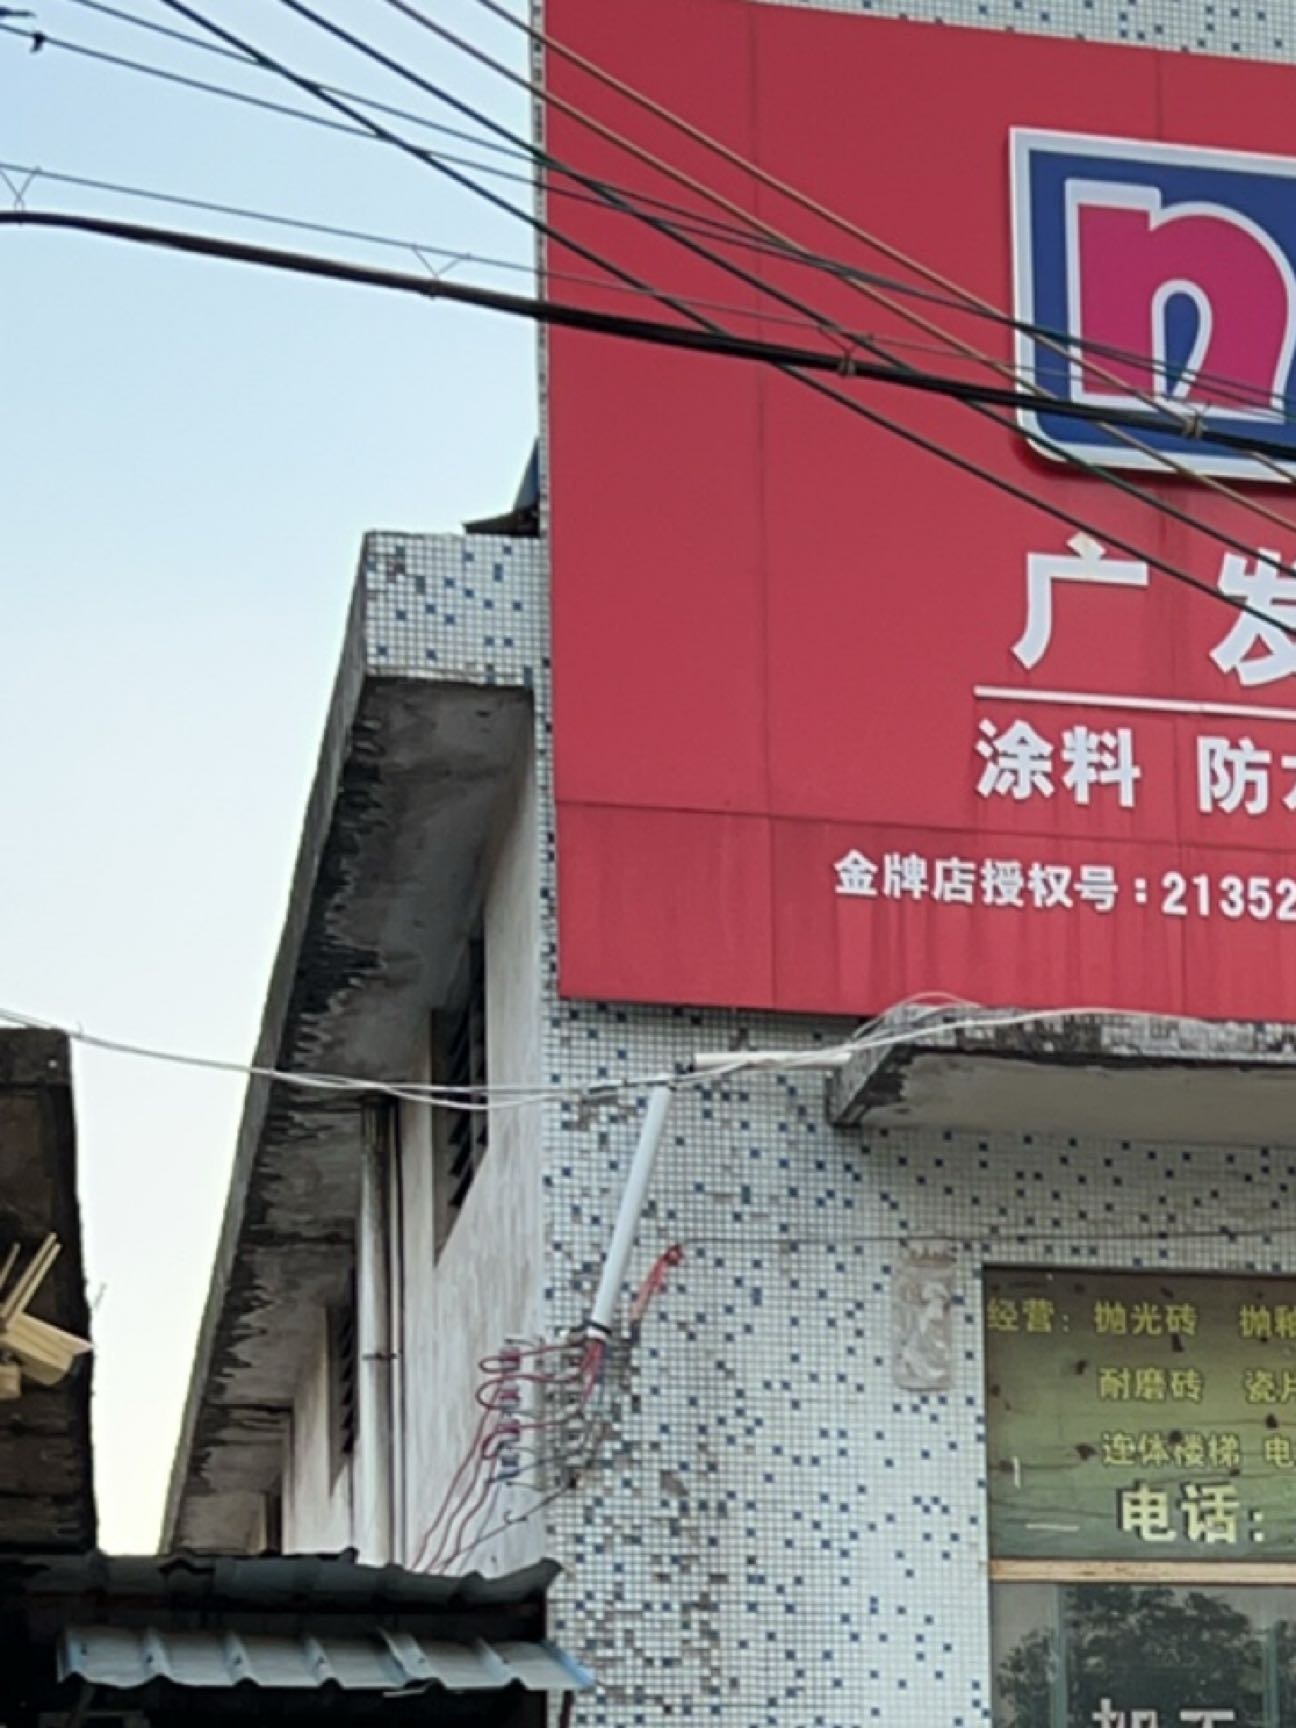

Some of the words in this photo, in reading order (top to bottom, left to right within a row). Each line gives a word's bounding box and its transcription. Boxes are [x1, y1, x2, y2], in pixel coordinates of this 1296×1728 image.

[974, 718, 1142, 809] 涂料
[1094, 1302, 1198, 1337] 抛光砖
[1098, 1367, 1204, 1401] 耐磨砖
[1101, 1431, 1242, 1467] 连体楼梯
